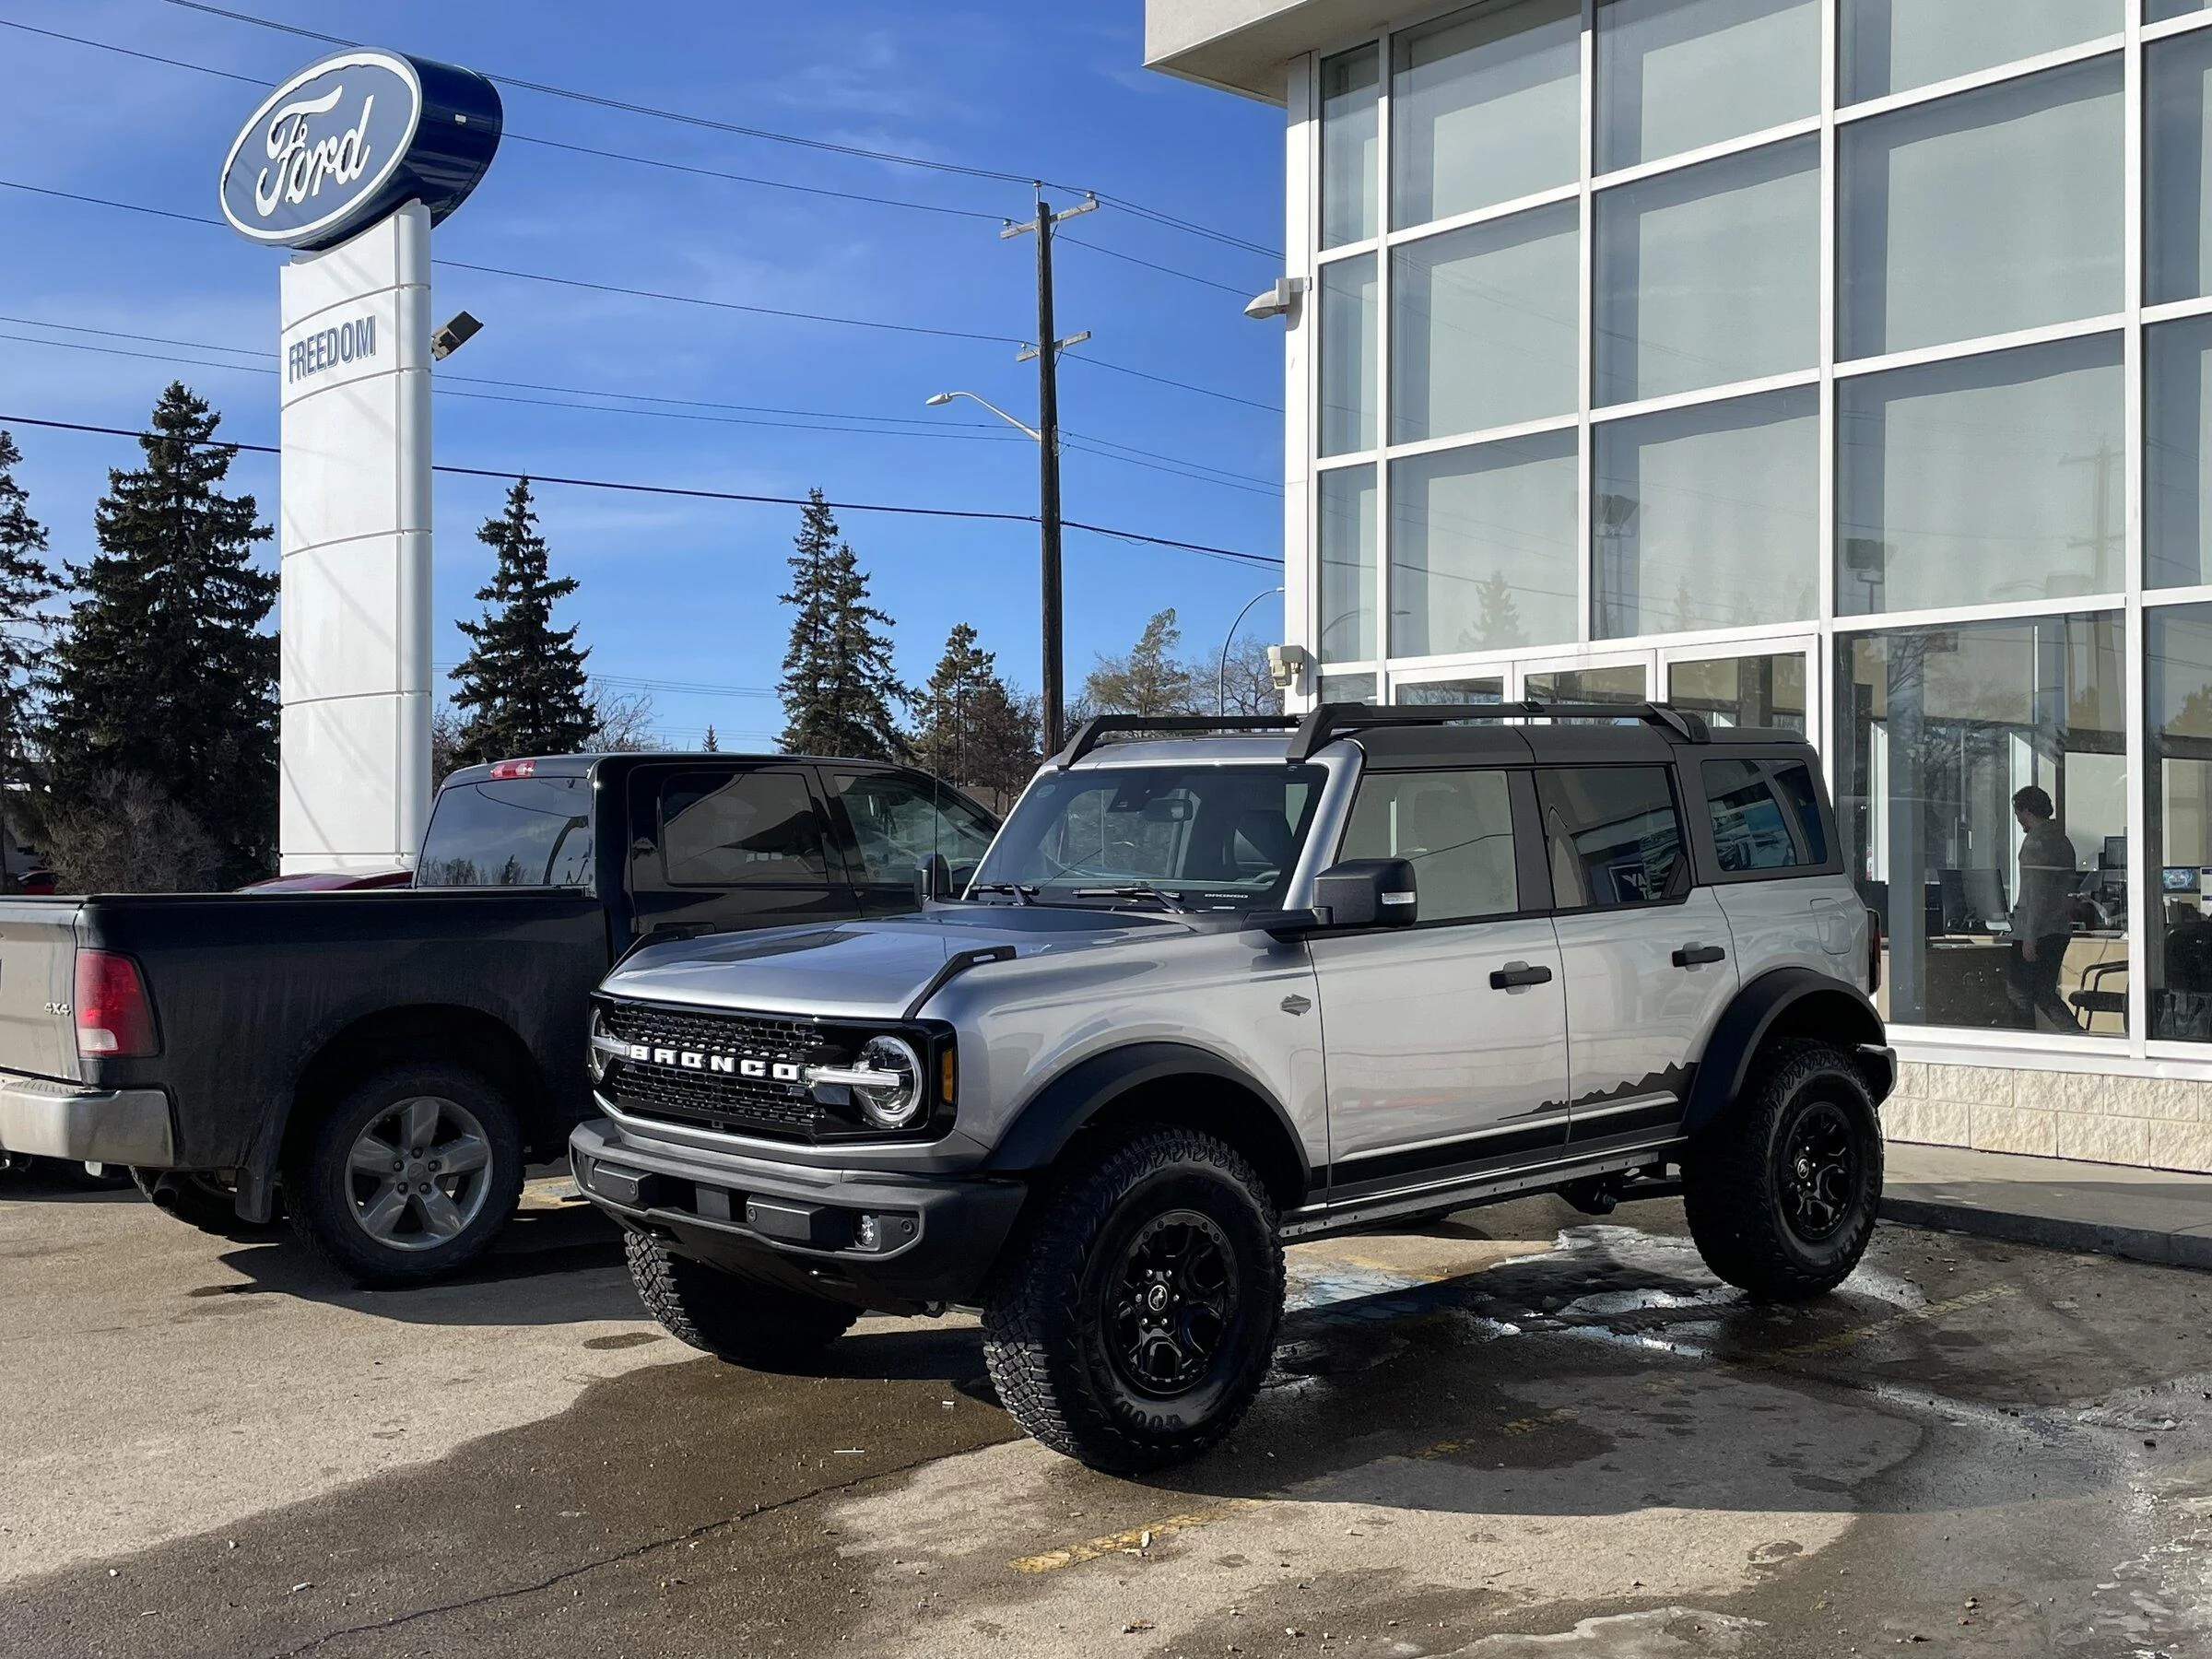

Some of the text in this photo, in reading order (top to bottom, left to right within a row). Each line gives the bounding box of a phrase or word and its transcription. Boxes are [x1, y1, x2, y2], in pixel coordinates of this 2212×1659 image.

[255, 85, 374, 217] Ford
[288, 315, 376, 384] FREEDOM
[630, 1043, 801, 1081] BRONCO
